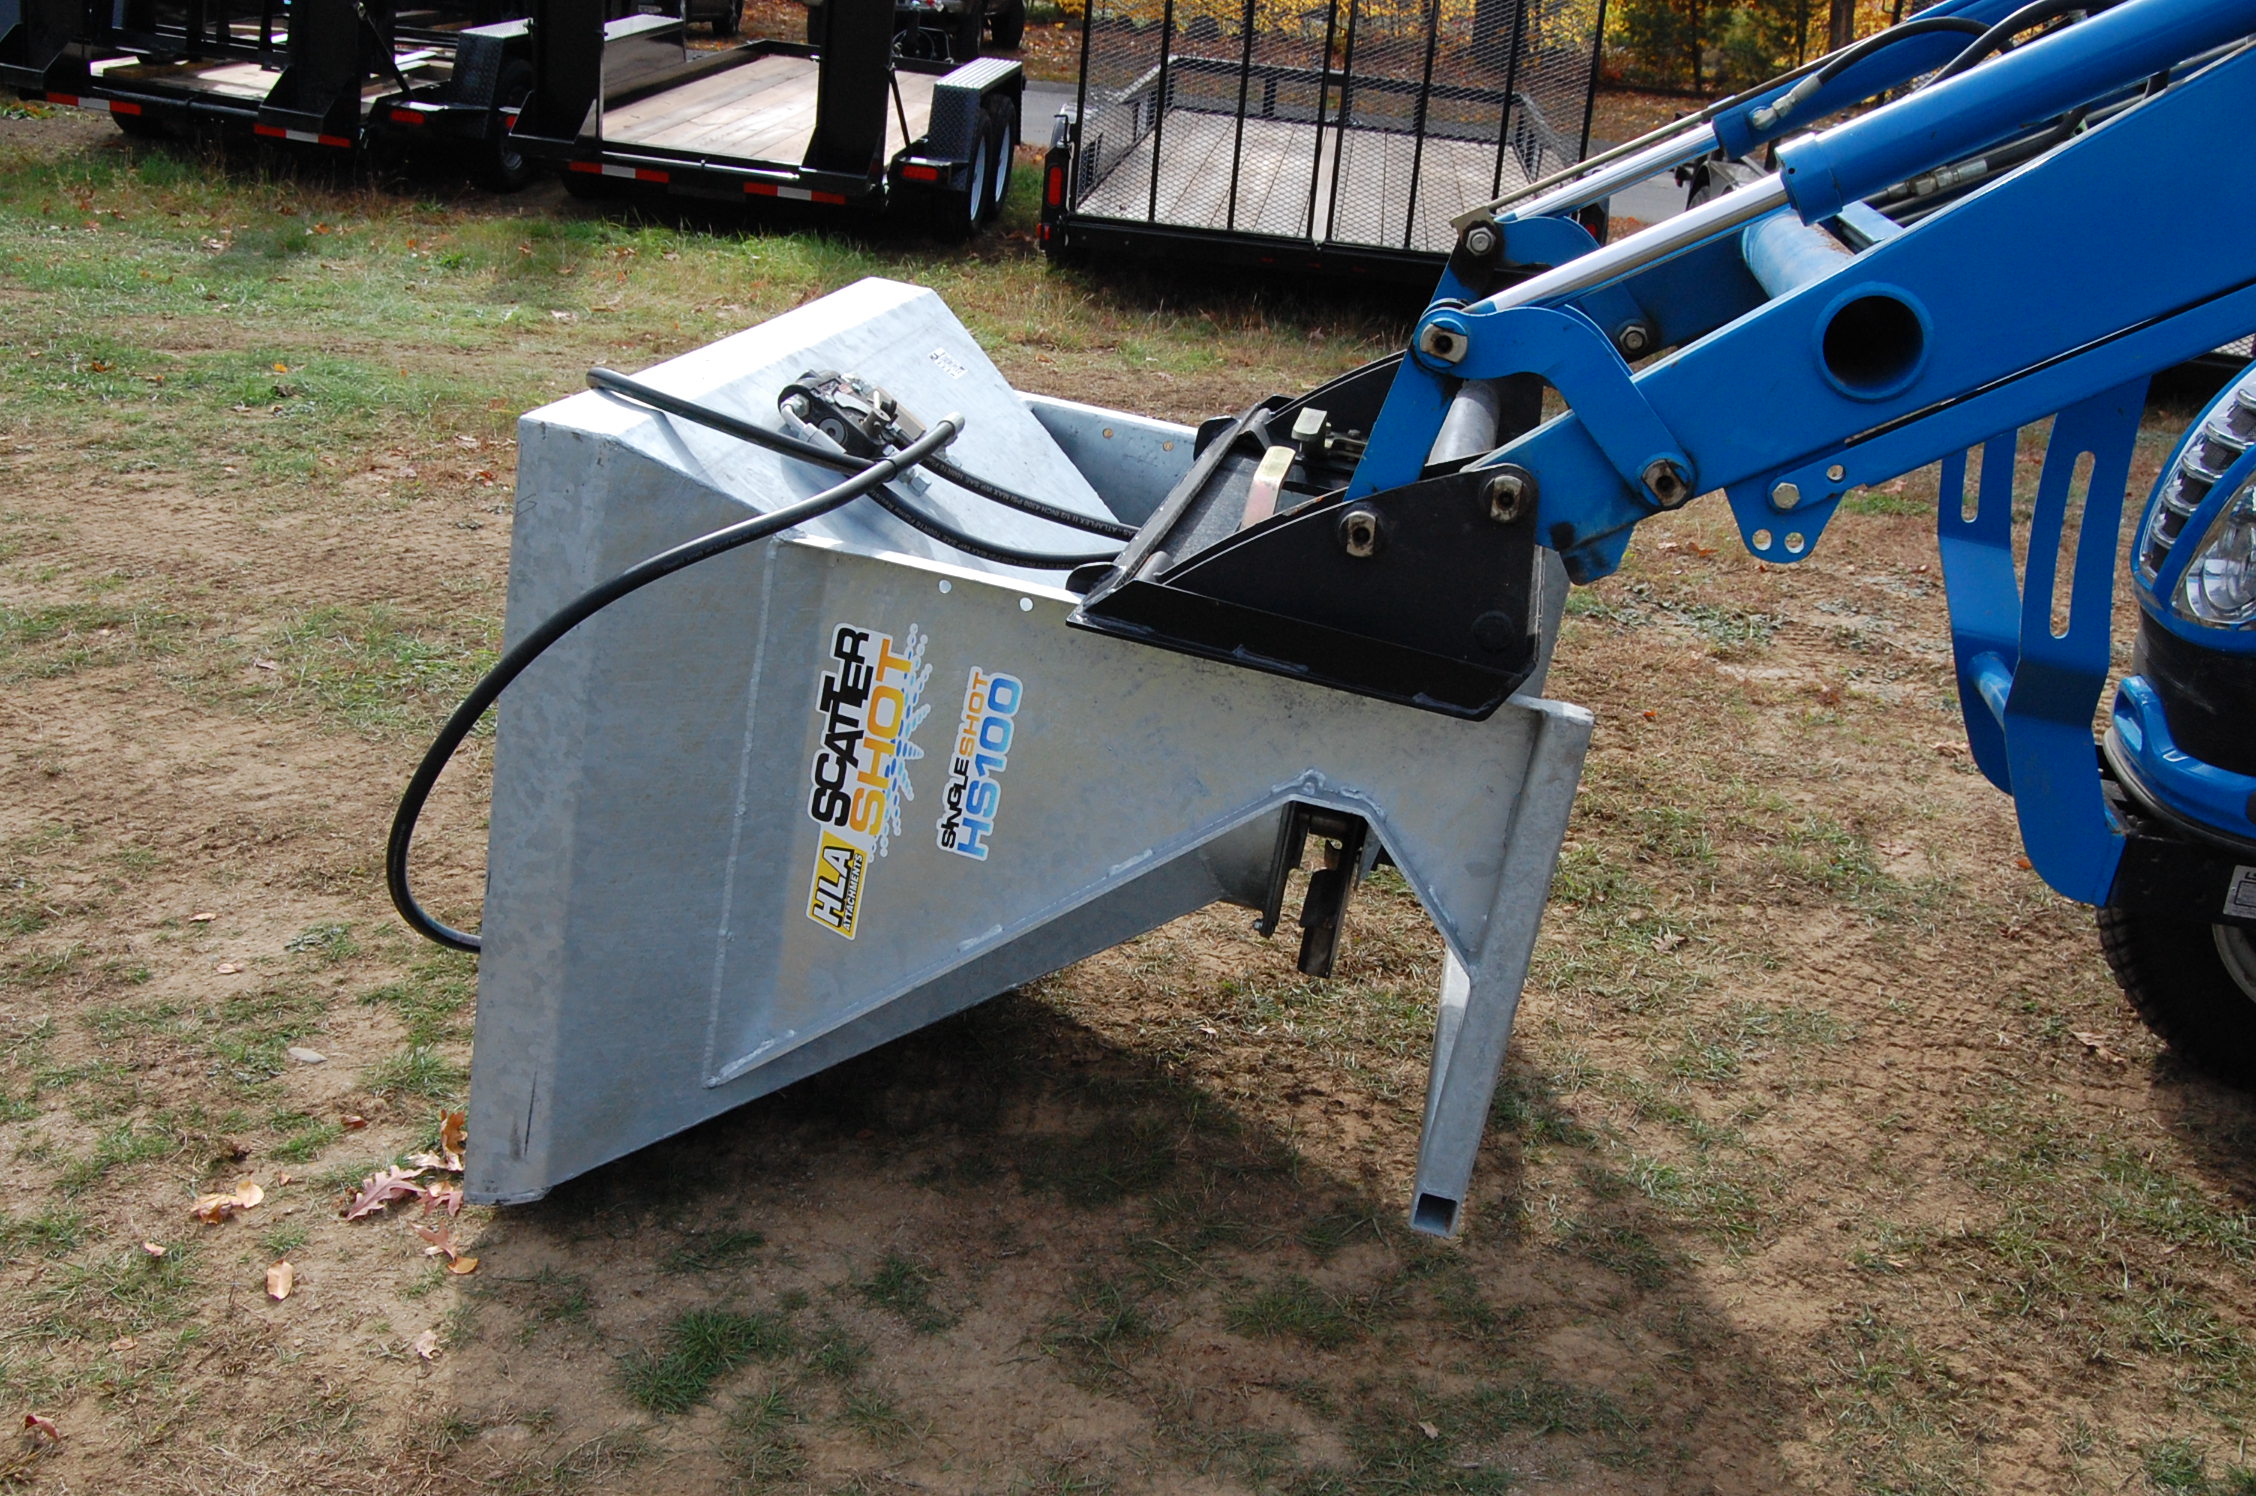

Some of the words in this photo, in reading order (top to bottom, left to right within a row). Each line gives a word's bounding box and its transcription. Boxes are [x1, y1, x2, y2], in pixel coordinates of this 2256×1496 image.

[991, 488, 1010, 501] MAX
[1039, 505, 1060, 517] INCH
[811, 627, 873, 827] SCATTER
[849, 638, 912, 836] SHOT
[957, 677, 1021, 857] HS100
[812, 846, 855, 927] HLA
[842, 853, 863, 931] ATTACHMENTS
